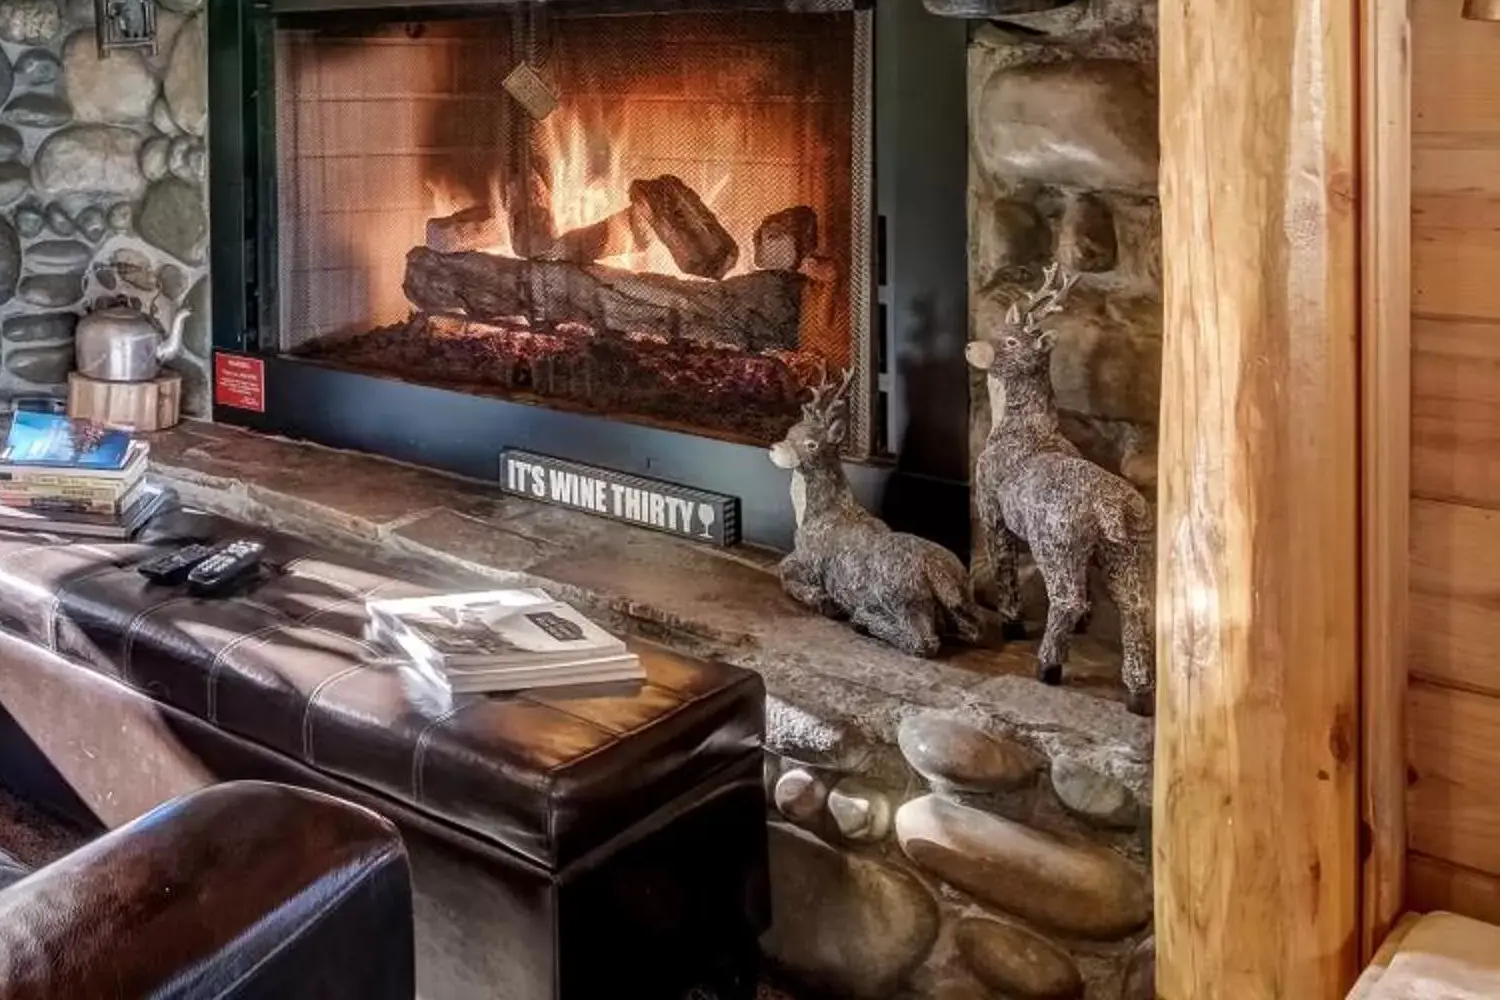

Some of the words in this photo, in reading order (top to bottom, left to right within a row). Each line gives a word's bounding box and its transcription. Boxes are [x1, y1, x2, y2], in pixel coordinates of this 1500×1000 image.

[506, 459, 546, 497] IT'S
[550, 469, 607, 513] WINE
[612, 483, 695, 533] THIRTY
